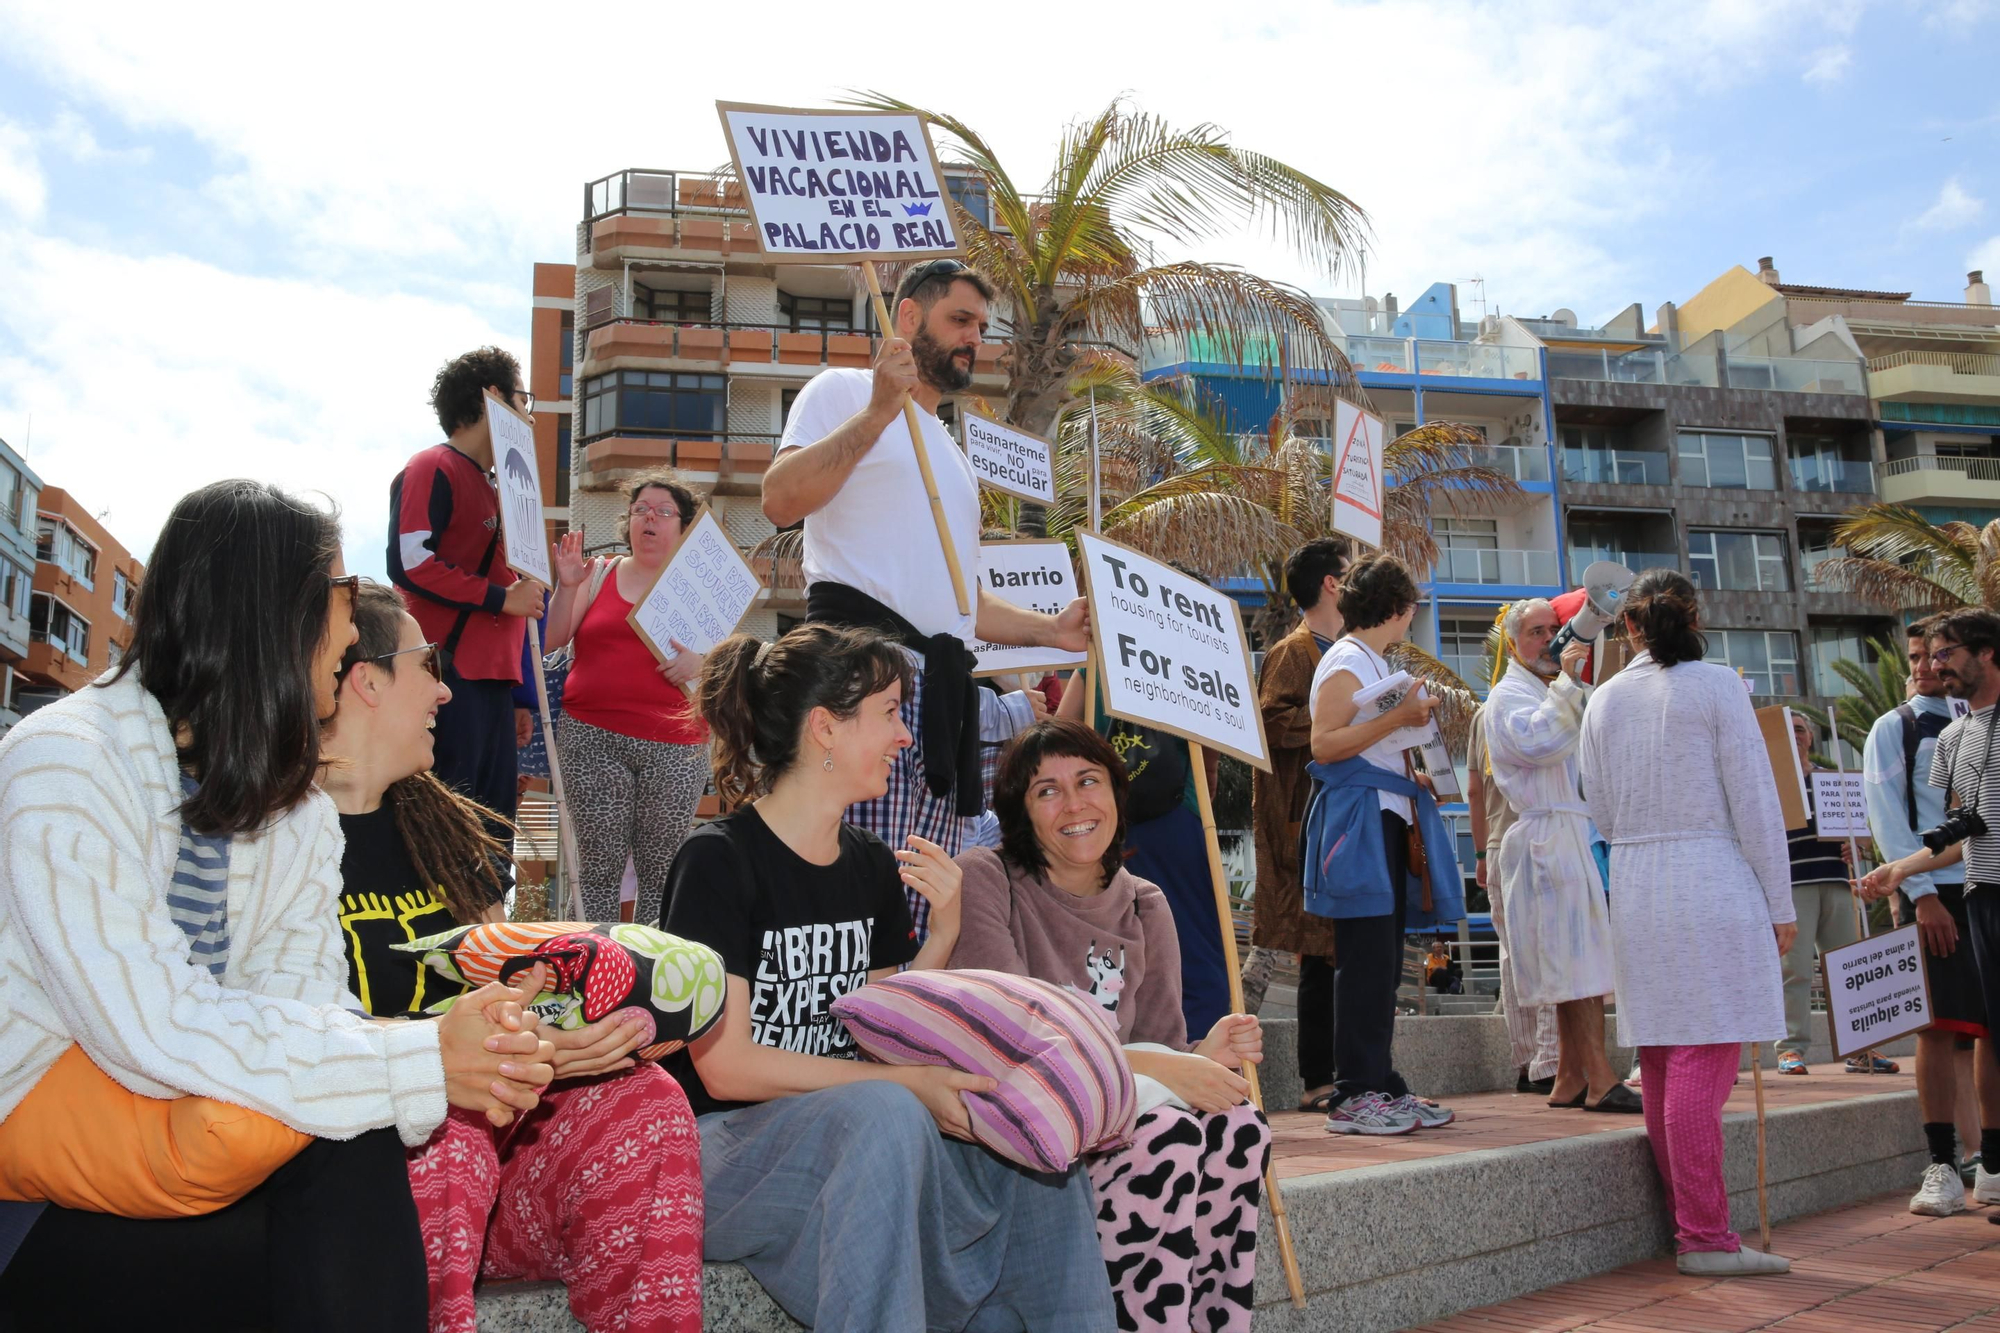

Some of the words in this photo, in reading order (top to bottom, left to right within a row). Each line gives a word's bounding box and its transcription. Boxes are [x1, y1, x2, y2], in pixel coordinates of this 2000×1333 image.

[746, 126, 918, 162] VIVIENDA
[746, 166, 940, 199] VACACIONAL
[828, 199, 857, 218] EN
[863, 200, 892, 218] EL
[764, 222, 881, 250] PALACIO
[892, 219, 956, 249] REAL
[969, 423, 1046, 463] Guanarteme
[970, 437, 985, 449] para
[986, 443, 1002, 457] vivir,
[972, 454, 1048, 492] especular
[1007, 453, 1025, 470] NO
[1031, 467, 1047, 477] para
[699, 530, 728, 571] BYE
[724, 566, 754, 606] BYE
[989, 566, 1063, 588] barrio
[666, 567, 701, 614] ESTE
[685, 549, 742, 626] SOUVENIR
[1102, 554, 1149, 599] To
[1160, 583, 1225, 634] rent
[649, 590, 670, 614] ES
[668, 609, 698, 651] PARA
[1111, 591, 1164, 630] housing
[1167, 613, 1184, 634] for
[1187, 624, 1230, 655] tourists
[1117, 633, 1172, 681] For
[1182, 664, 1240, 709] sale
[1224, 714, 1246, 732] soul
[1885, 945, 1905, 956] alma
[1907, 940, 1915, 948] el
[1842, 956, 1868, 971] barrio
[1870, 951, 1883, 963] del
[1898, 955, 1917, 972] Se
[1845, 964, 1893, 991] vende
[1876, 993, 1892, 1005] para
[1893, 984, 1921, 999] vivienda
[1849, 1001, 1875, 1015] turistas
[1904, 997, 1922, 1013] Se
[1851, 1004, 1900, 1032] alquila
